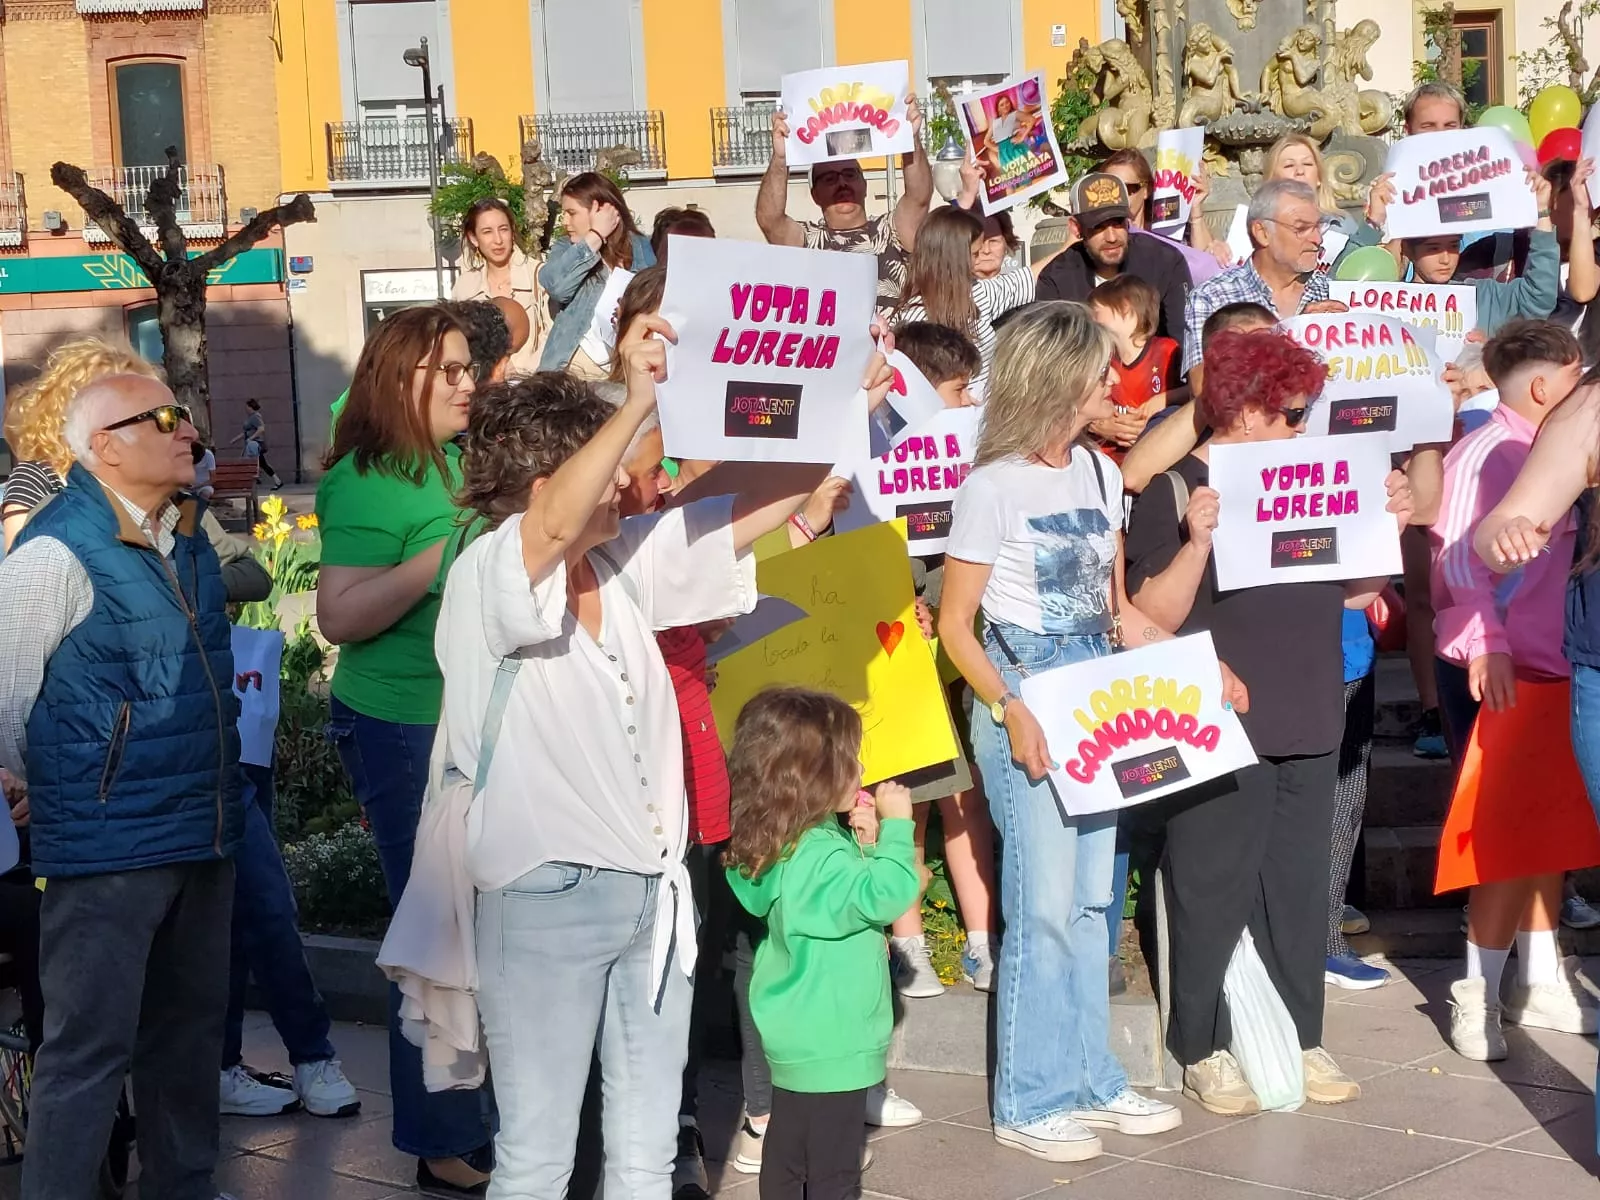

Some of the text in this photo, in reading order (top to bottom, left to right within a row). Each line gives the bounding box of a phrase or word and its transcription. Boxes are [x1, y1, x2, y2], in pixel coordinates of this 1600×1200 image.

[797, 102, 900, 144] GANADORA
[989, 152, 1051, 186] LORENA MATA
[1002, 150, 1036, 172] VOTA A
[1419, 145, 1489, 181] LORENA
[1154, 168, 1195, 205] ADORA
[1403, 185, 1426, 205] LA
[729, 282, 837, 327] VOTA A
[1350, 289, 1457, 313] LORENA A
[711, 327, 841, 369] LORENA
[1401, 327, 1415, 345] A
[730, 396, 795, 416] JOTALENT
[1336, 405, 1393, 421] JOTALENT
[748, 415, 772, 426] 2024
[1352, 417, 1374, 426] 2024
[944, 433, 961, 458] A
[1261, 460, 1350, 492] VOTA A
[907, 510, 951, 526] OTALENT
[1256, 489, 1359, 523] LORENA
[916, 523, 936, 533] 2024
[1276, 537, 1332, 553] JOTALENT
[1073, 674, 1202, 735] LORENA
[1065, 707, 1221, 785] GANADORA
[1121, 755, 1179, 784] JOTALENT
[1140, 773, 1163, 786] 2024
